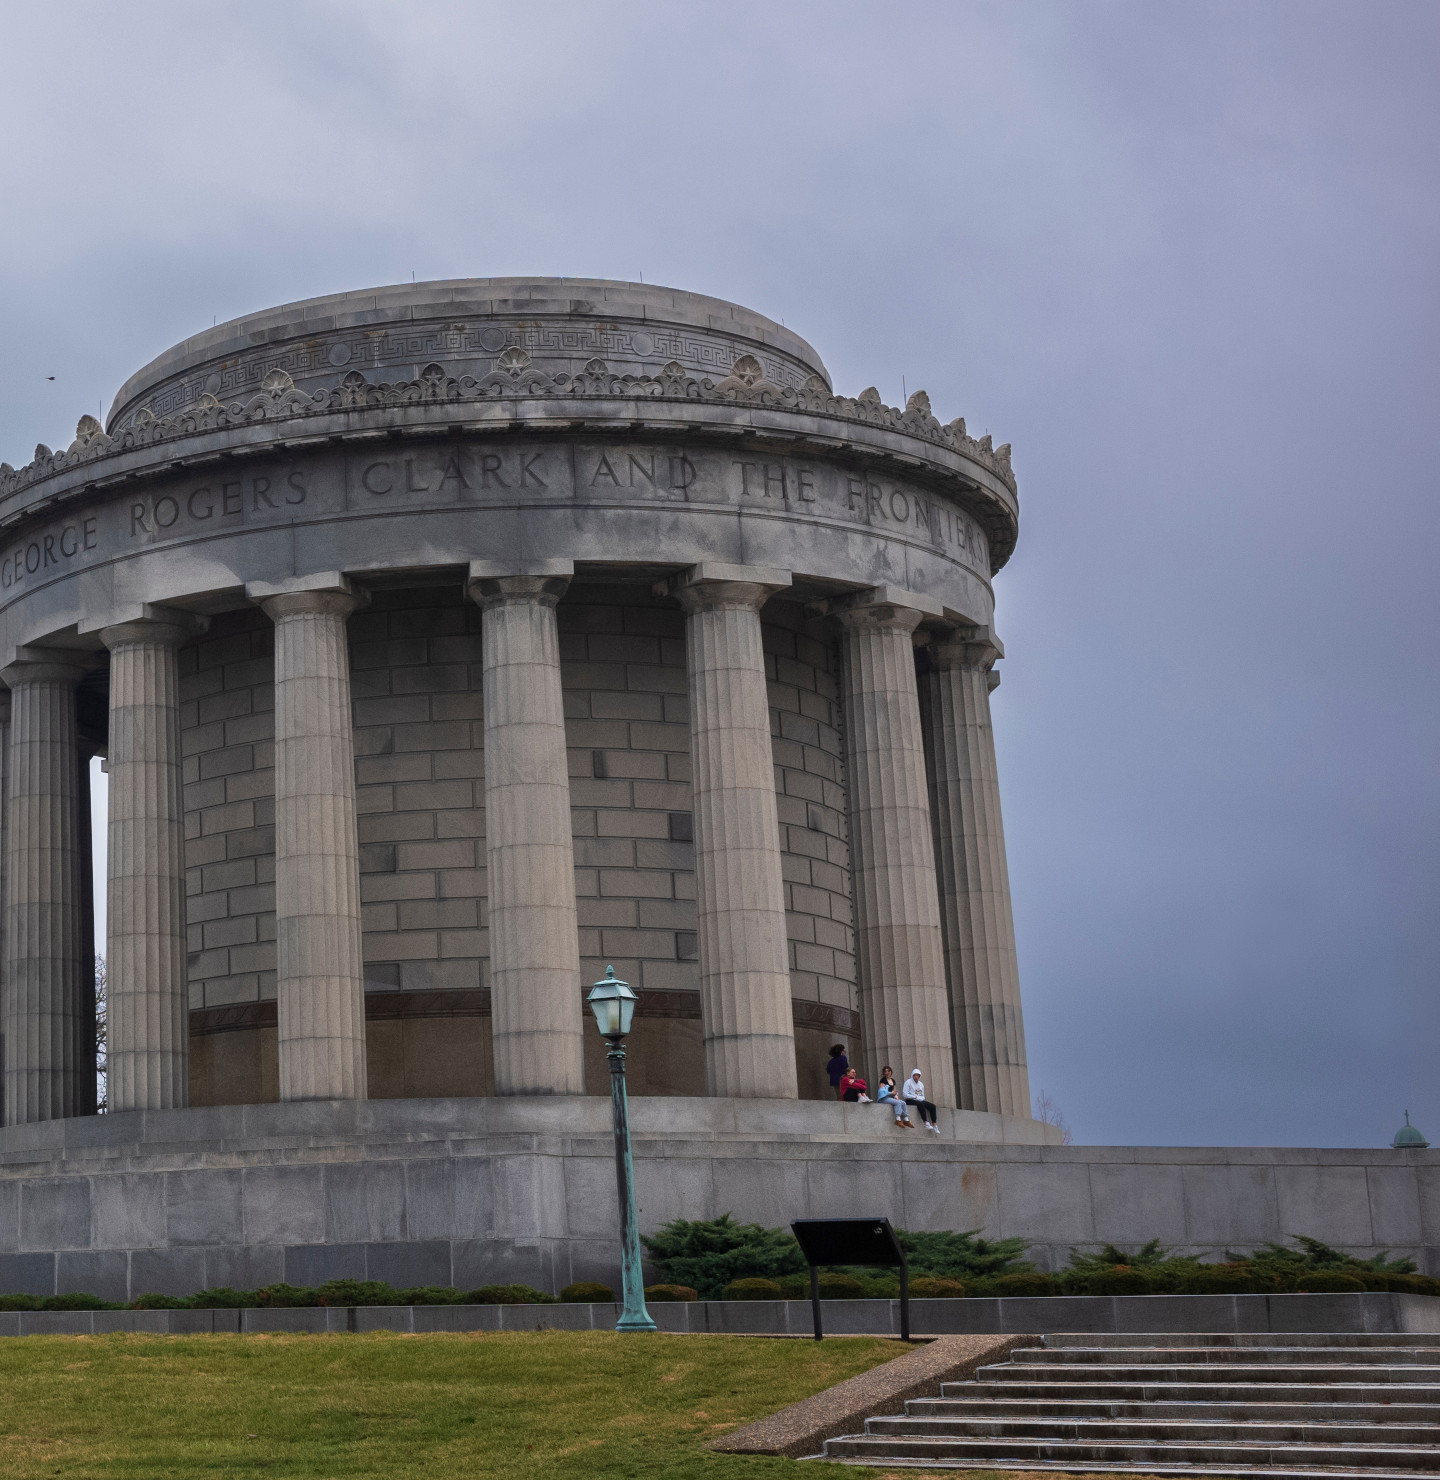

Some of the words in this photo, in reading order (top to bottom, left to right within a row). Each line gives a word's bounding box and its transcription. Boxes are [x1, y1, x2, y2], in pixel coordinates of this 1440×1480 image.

[1, 516, 97, 589] GEORGE
[129, 470, 307, 538] ROGERS
[362, 452, 549, 496] CLARK
[588, 453, 698, 490] AND
[732, 460, 815, 503] THE
[846, 476, 989, 571] FRONTIERS
